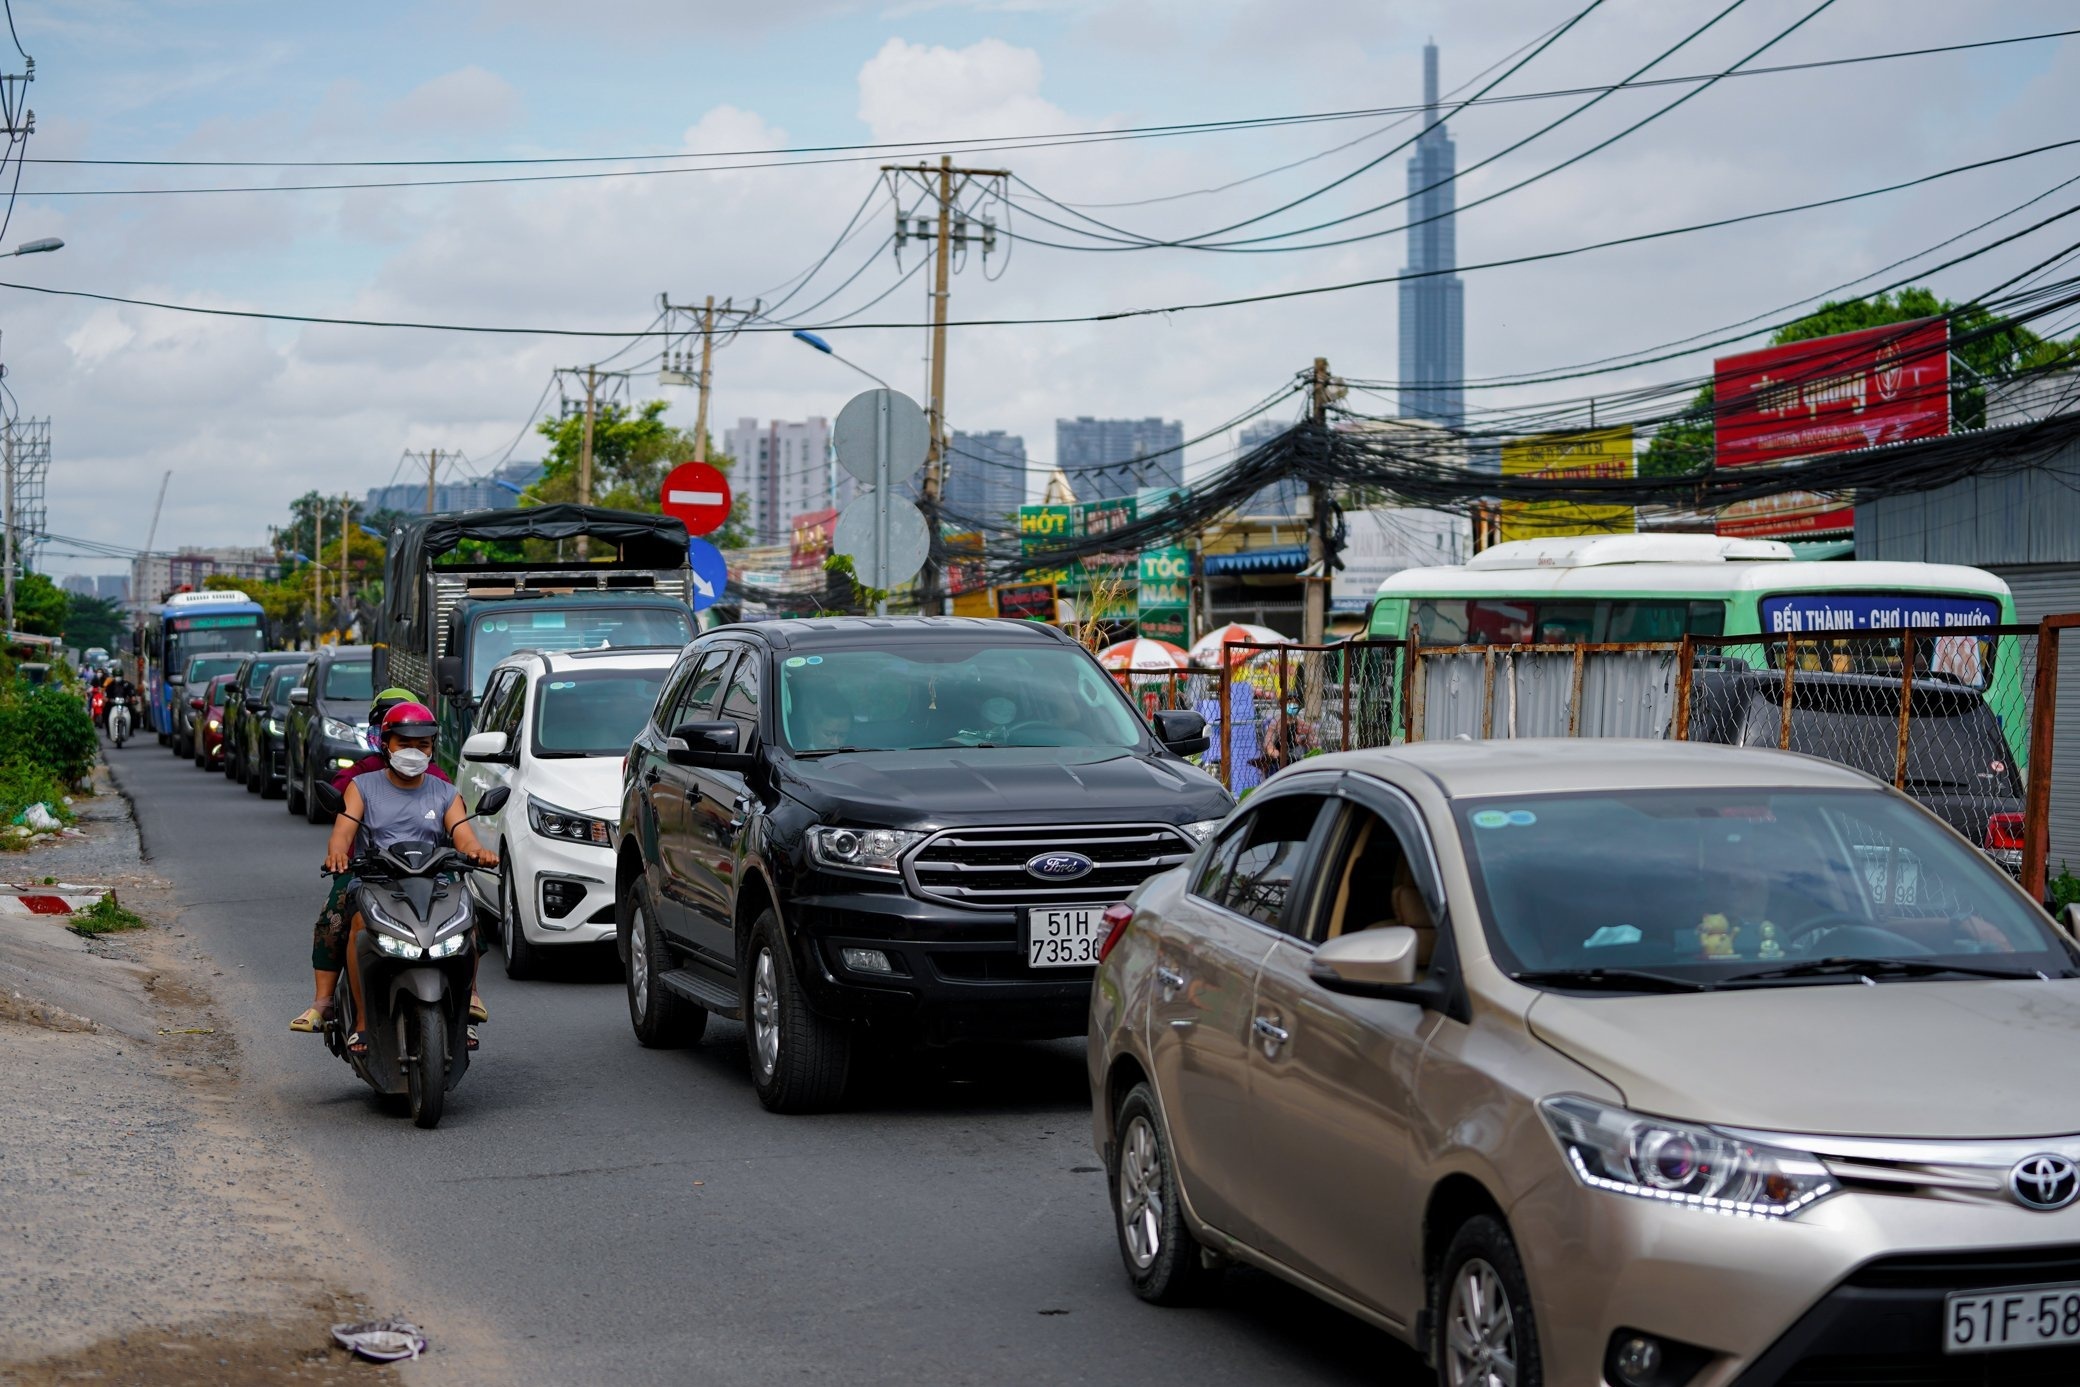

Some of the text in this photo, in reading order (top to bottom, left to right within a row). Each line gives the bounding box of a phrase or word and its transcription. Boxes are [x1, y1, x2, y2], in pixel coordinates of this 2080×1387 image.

[1142, 583, 1187, 603] NAM
[1773, 603, 1802, 632] BẾN
[1806, 605, 1854, 631] THÀNH
[1044, 857, 1078, 874] Ford
[1048, 912, 1089, 936] 51H
[1954, 1294, 2080, 1344] 51F-58
